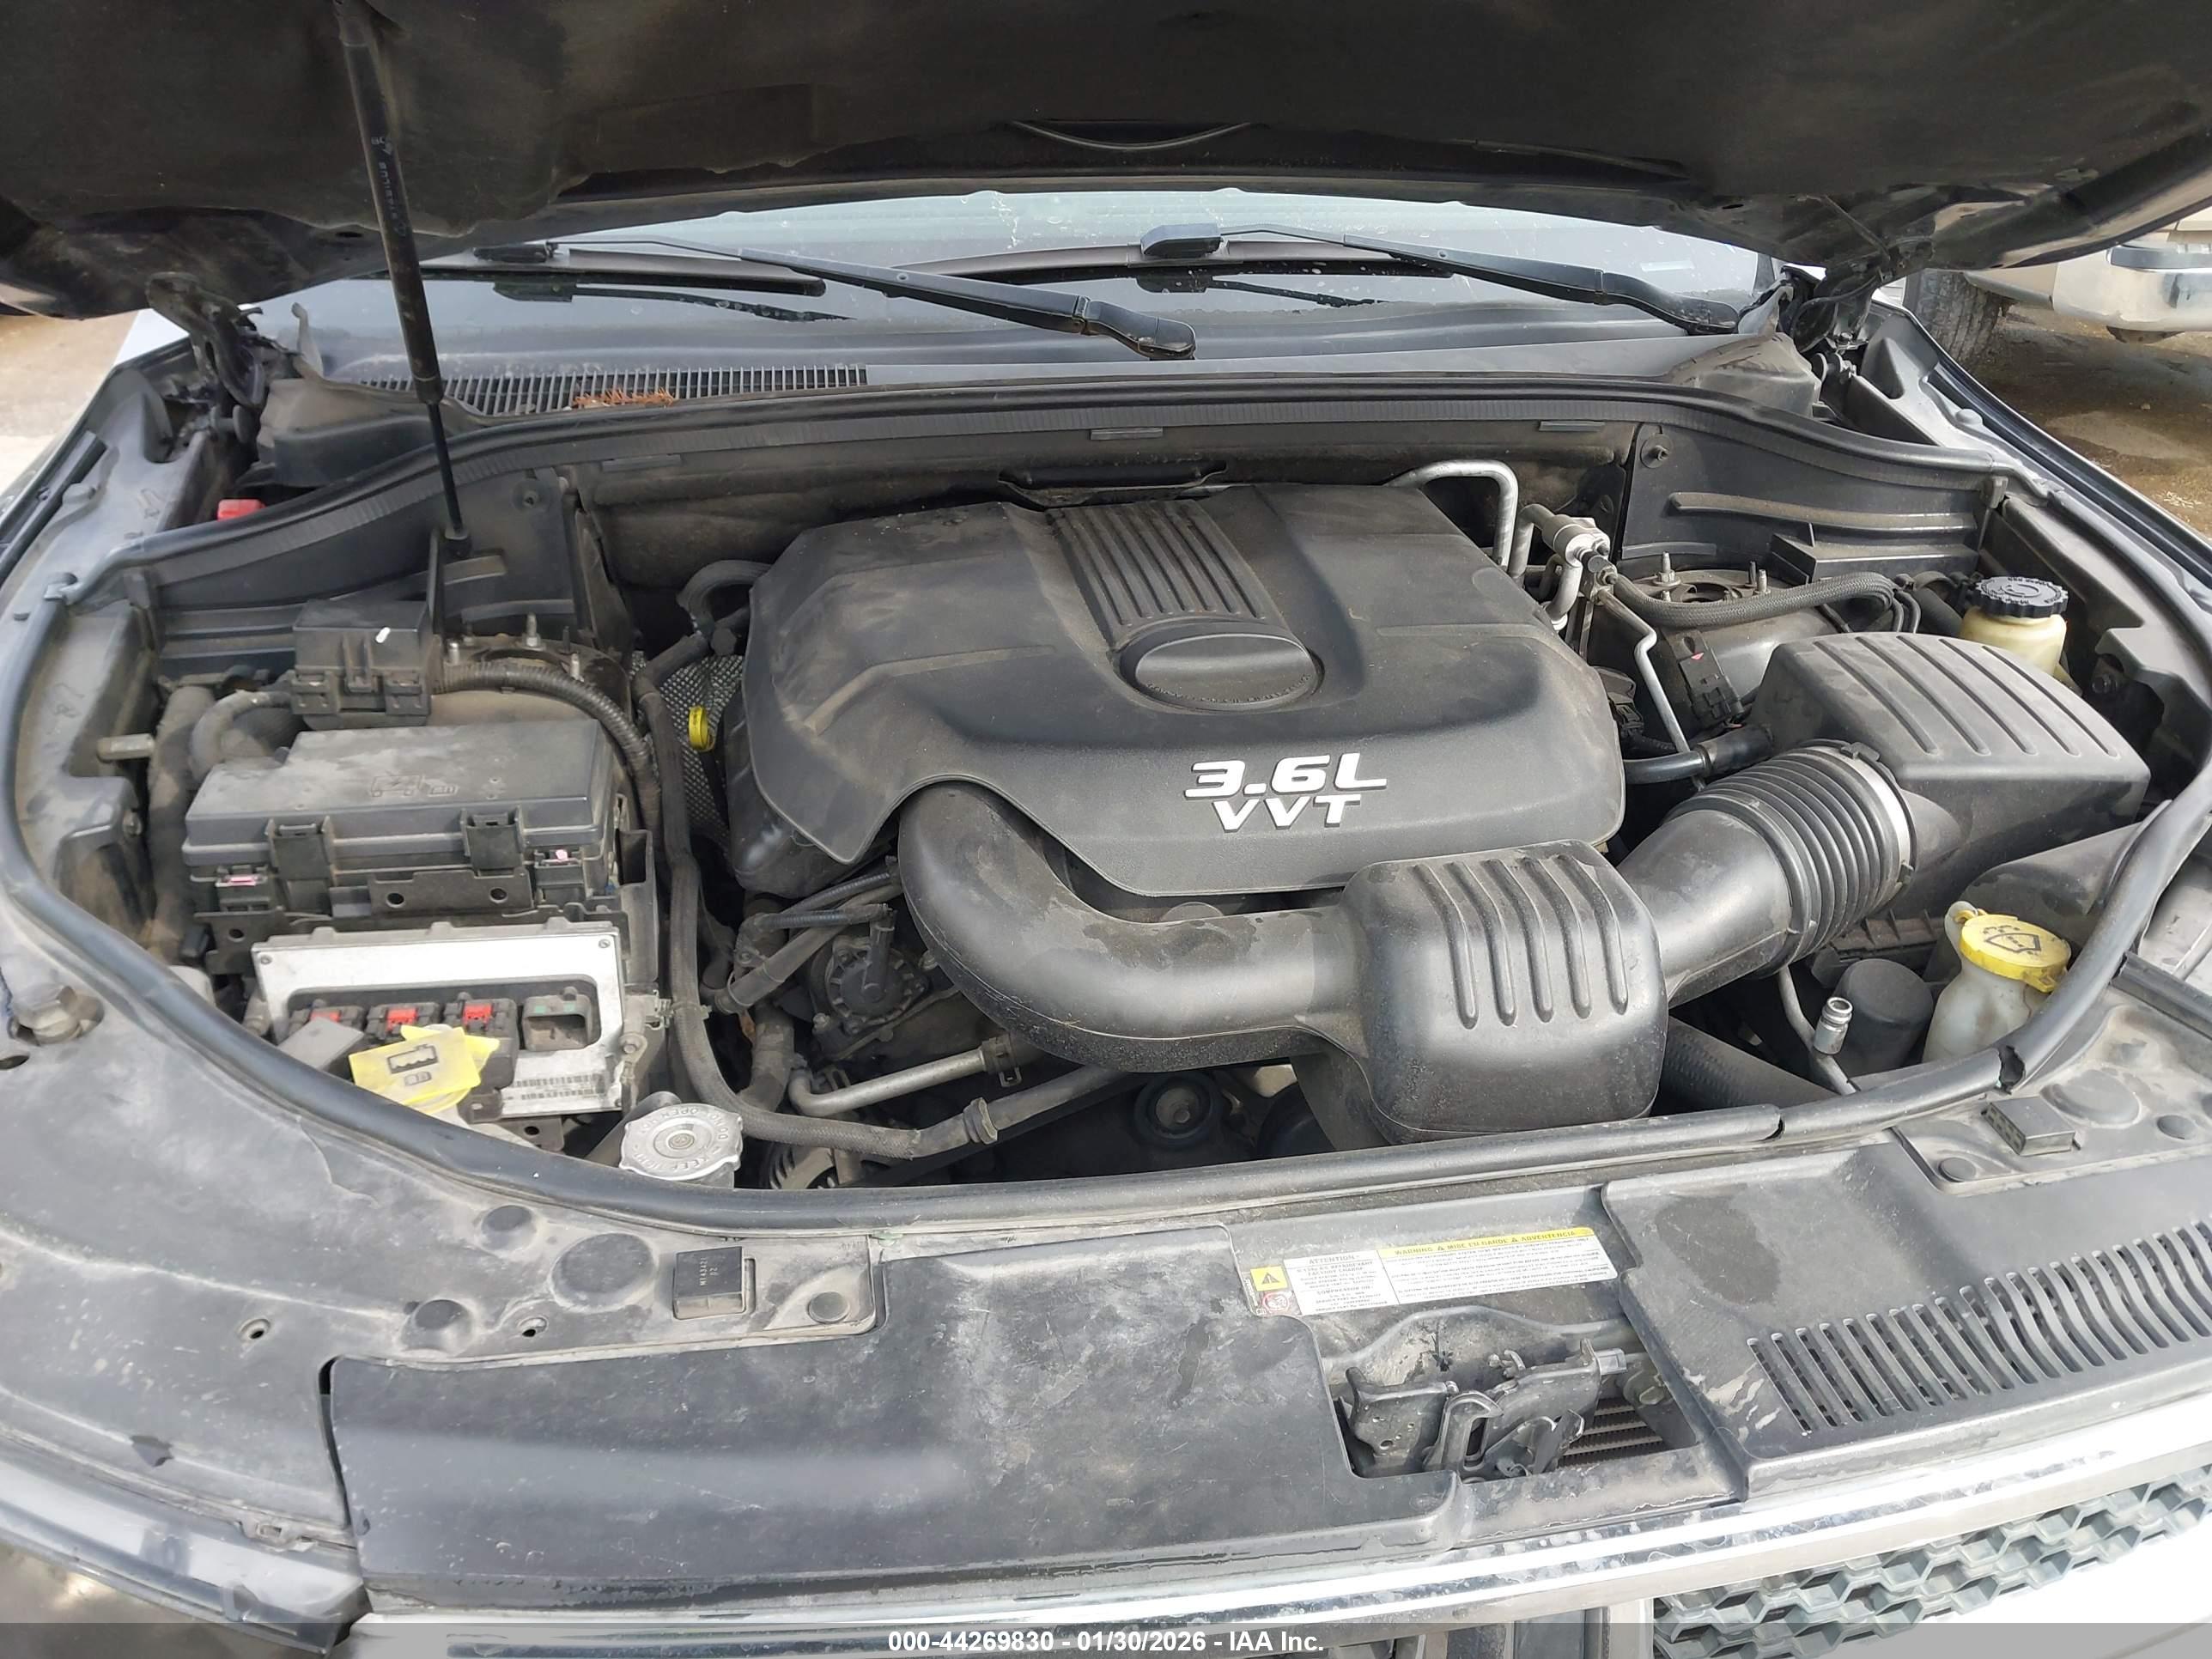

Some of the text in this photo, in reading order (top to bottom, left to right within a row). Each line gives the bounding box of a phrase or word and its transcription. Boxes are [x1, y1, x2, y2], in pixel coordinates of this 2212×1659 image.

[1183, 752, 1388, 799] 3.6L
[1212, 793, 1361, 833] VVT
[1395, 1247, 1433, 1255] WARNING
[1522, 1231, 1575, 1242] ADVERTENCIA
[1309, 1255, 1355, 1265] ATTENTION
